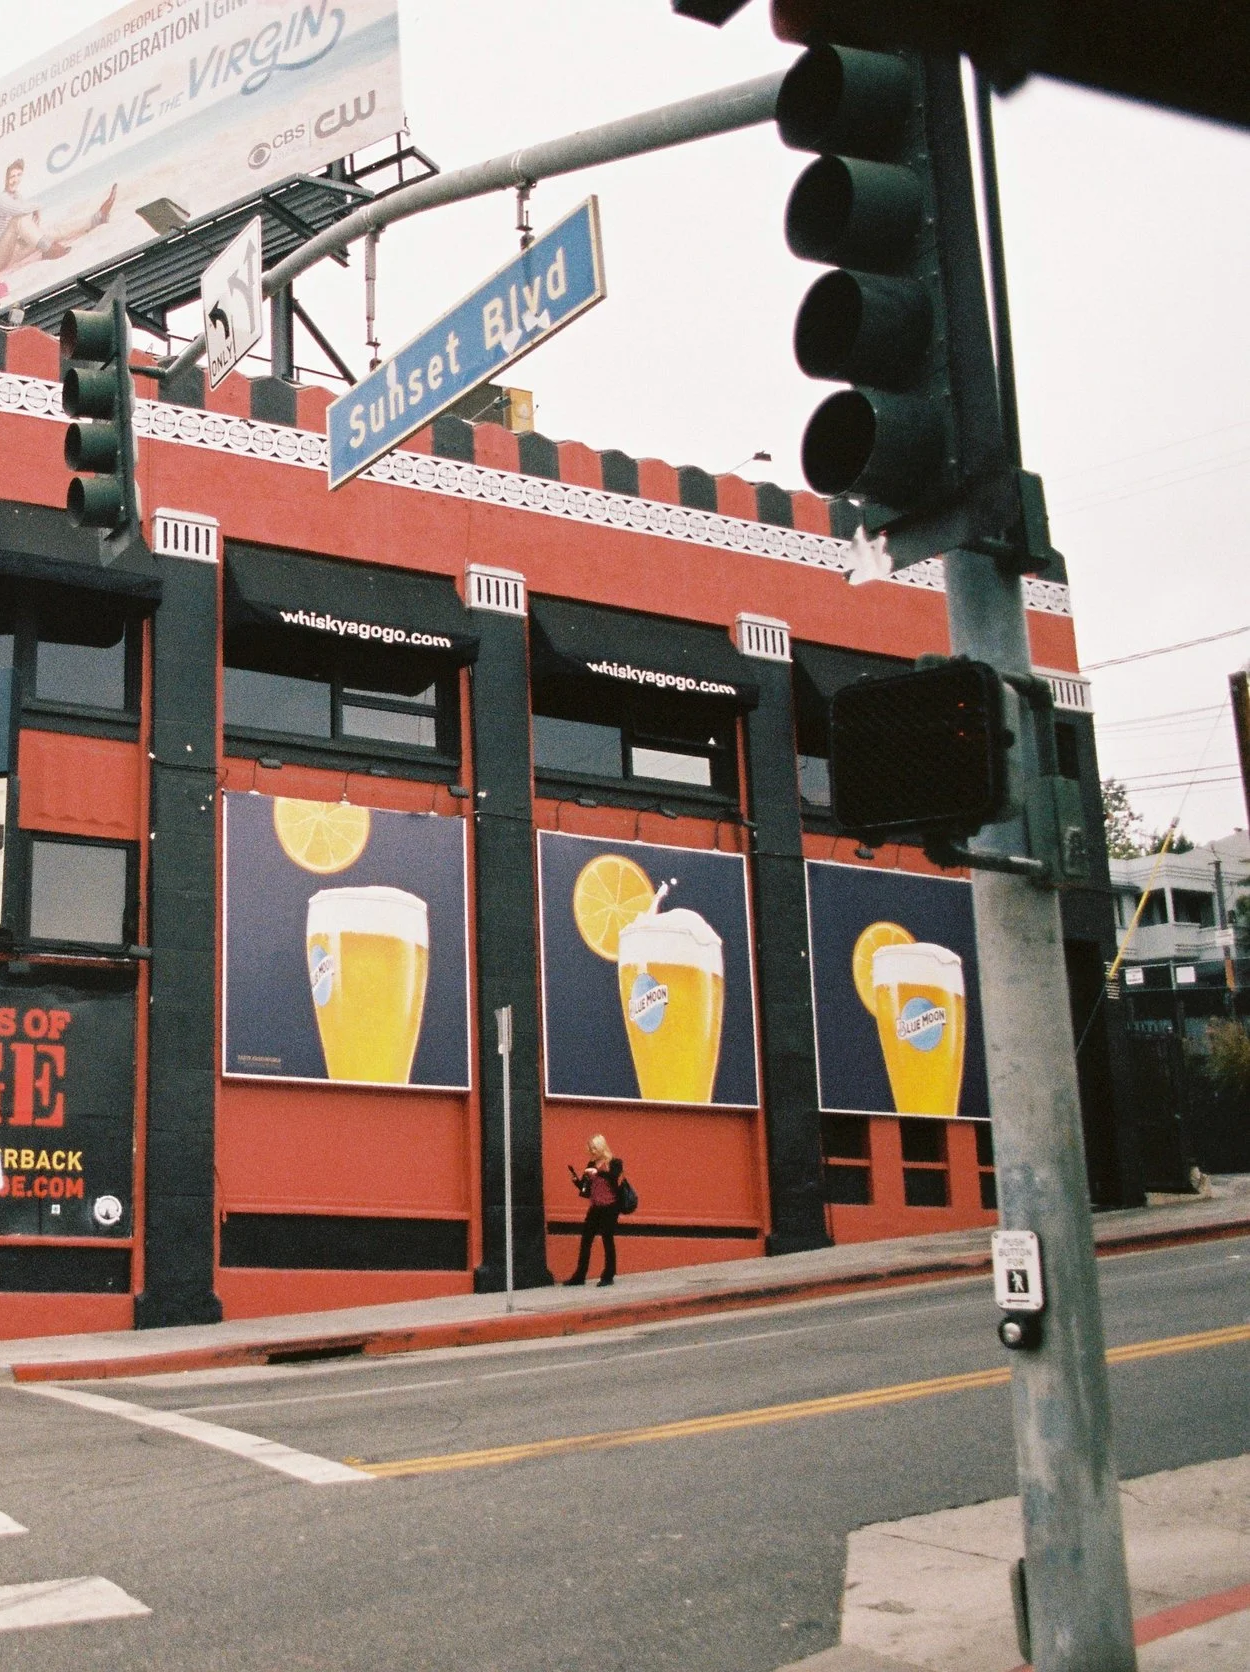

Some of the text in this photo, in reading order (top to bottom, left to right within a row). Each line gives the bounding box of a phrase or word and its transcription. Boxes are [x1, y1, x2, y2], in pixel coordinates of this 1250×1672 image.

[9, 72, 48, 103] GOLDEN
[50, 53, 82, 80] GLOBE
[83, 28, 121, 61] AWARD
[123, 0, 174, 39] PEOPLE'S
[20, 82, 67, 127] EMMY
[71, 7, 200, 98] CONSIDERATION
[46, 0, 346, 174] JANE THE VIRGIN
[273, 124, 305, 148] CBS
[211, 341, 235, 374] ONLY
[349, 247, 568, 449] Sunset Blvd
[279, 610, 452, 648] whiskyagogo.com
[587, 660, 737, 695] whiskyagogo.com
[646, 988, 667, 1007] MOON
[23, 1007, 72, 1040] OF
[897, 1010, 945, 1037] BLUE MOON
[998, 1248, 1032, 1257] BUTTON
[1002, 1238, 1025, 1246] PUSH
[1006, 1258, 1025, 1267] FOR
